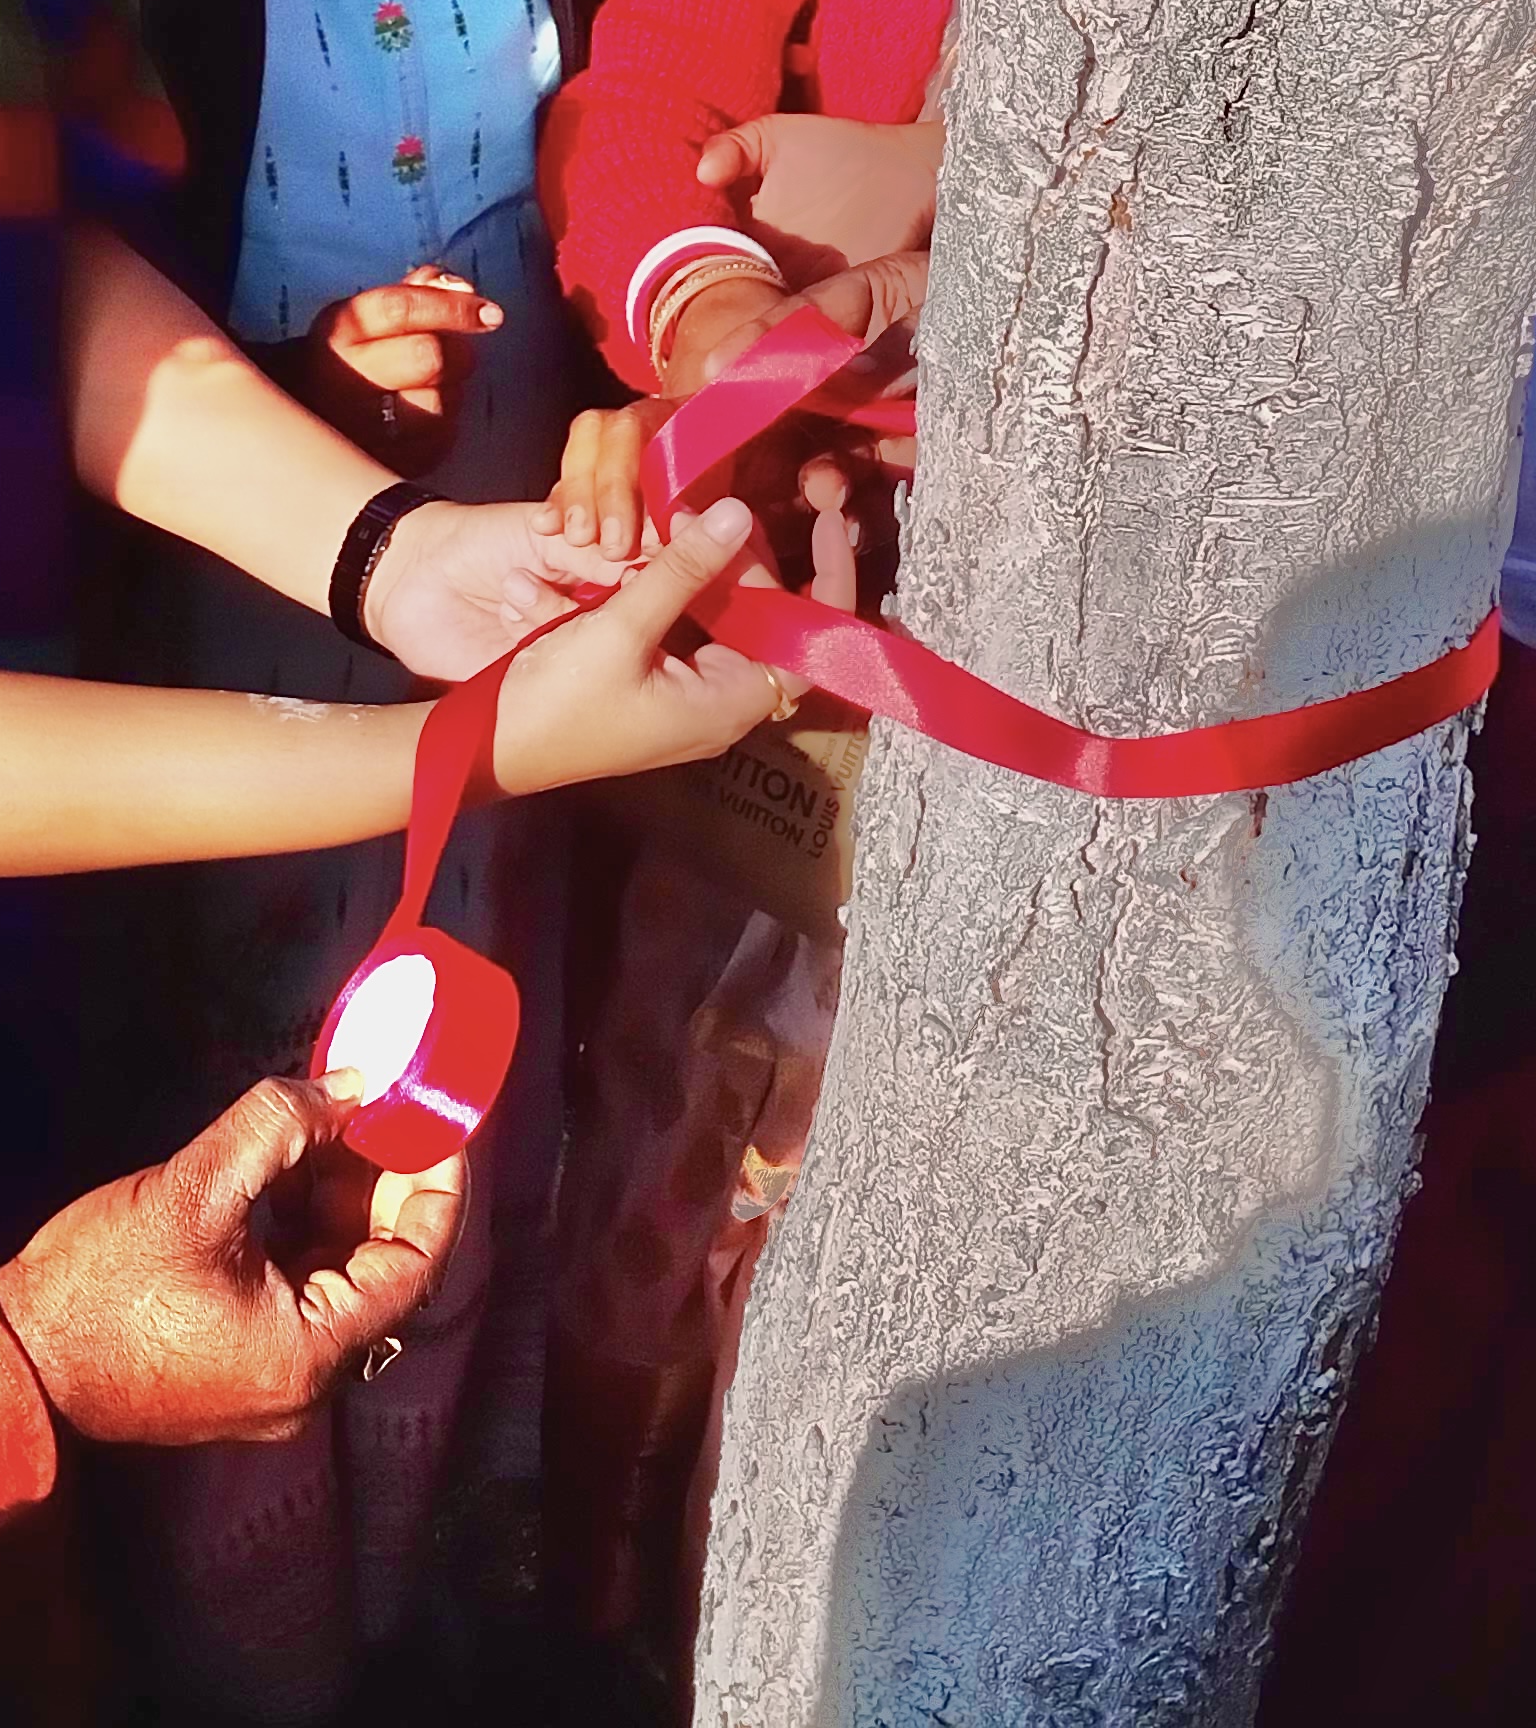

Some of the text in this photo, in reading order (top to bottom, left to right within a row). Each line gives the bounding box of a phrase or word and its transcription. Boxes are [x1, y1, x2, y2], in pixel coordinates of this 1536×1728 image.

[719, 786, 806, 848] VUITTON
[721, 747, 818, 819] ITTON
[807, 724, 868, 859] LOUIS VUITTO
